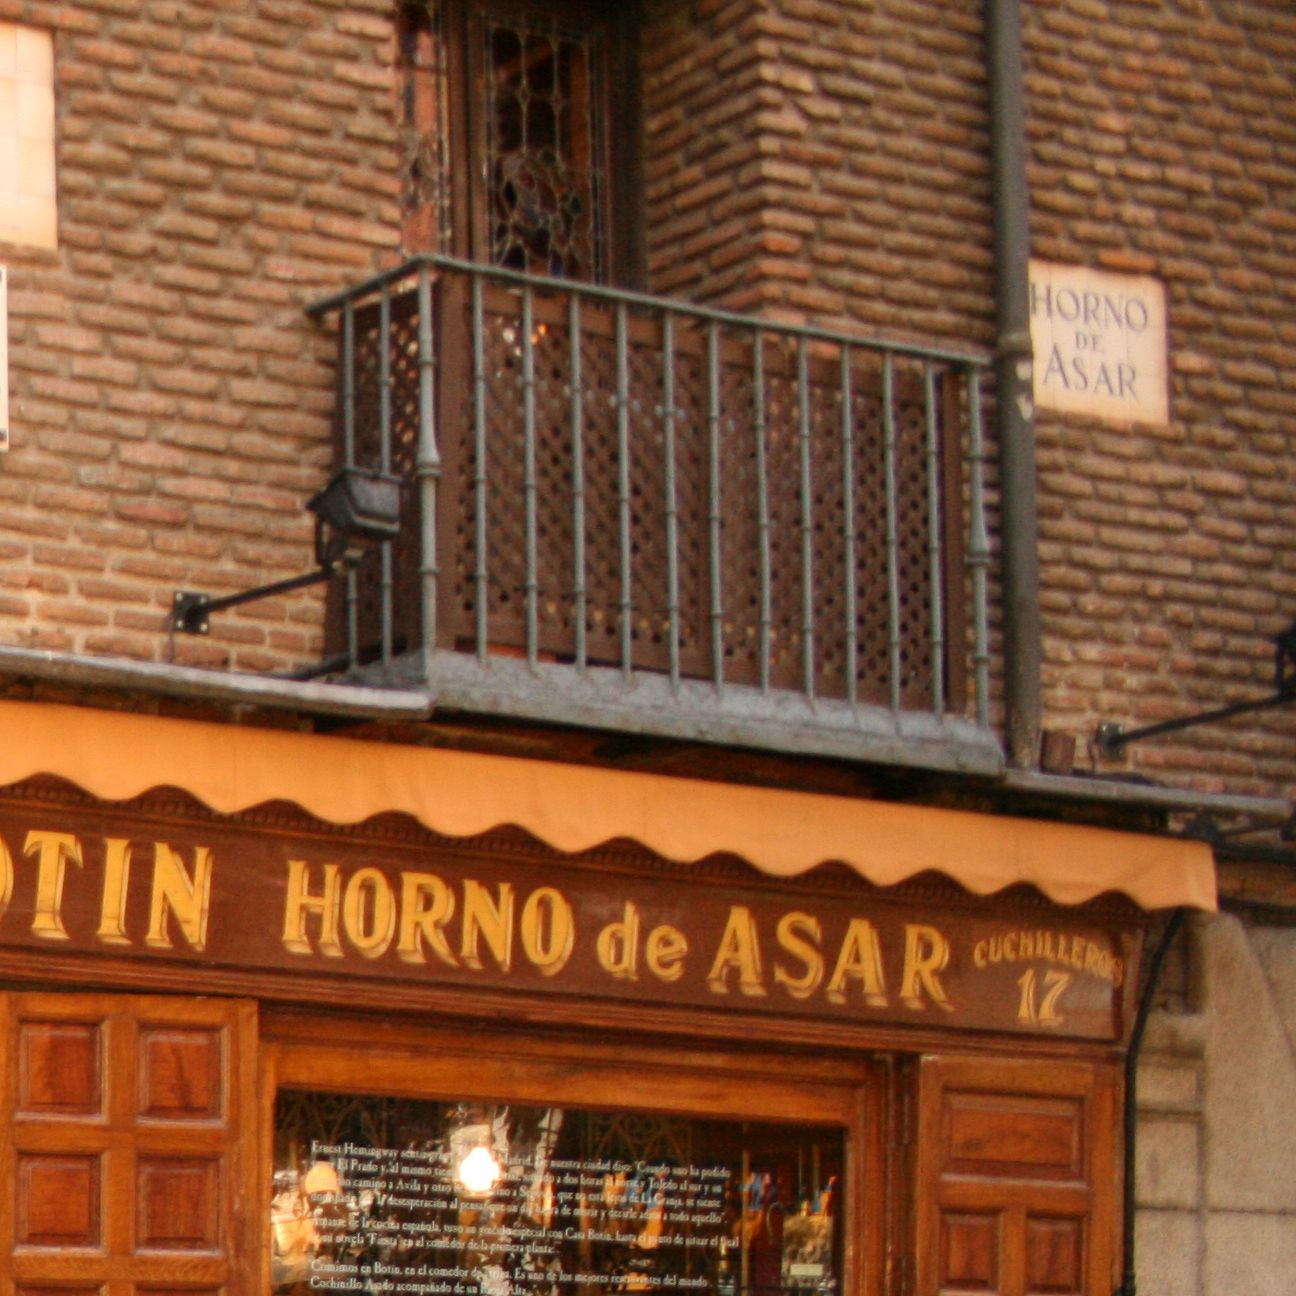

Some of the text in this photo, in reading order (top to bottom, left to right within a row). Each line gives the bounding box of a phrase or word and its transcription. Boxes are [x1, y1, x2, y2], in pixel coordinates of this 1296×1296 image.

[1030, 282, 1149, 334] HORNO
[1075, 331, 1105, 352] DE
[1044, 342, 1138, 399] ASAR
[281, 859, 576, 975] HORNO
[596, 901, 689, 982] de
[708, 904, 954, 1013] ASAR
[973, 930, 1124, 987] CUCHILLEROS
[311, 1139, 342, 1154] Ernest
[344, 1142, 398, 1160] Hemingway
[701, 1166, 731, 1181] podido
[310, 1274, 362, 1289] Cochinillo
